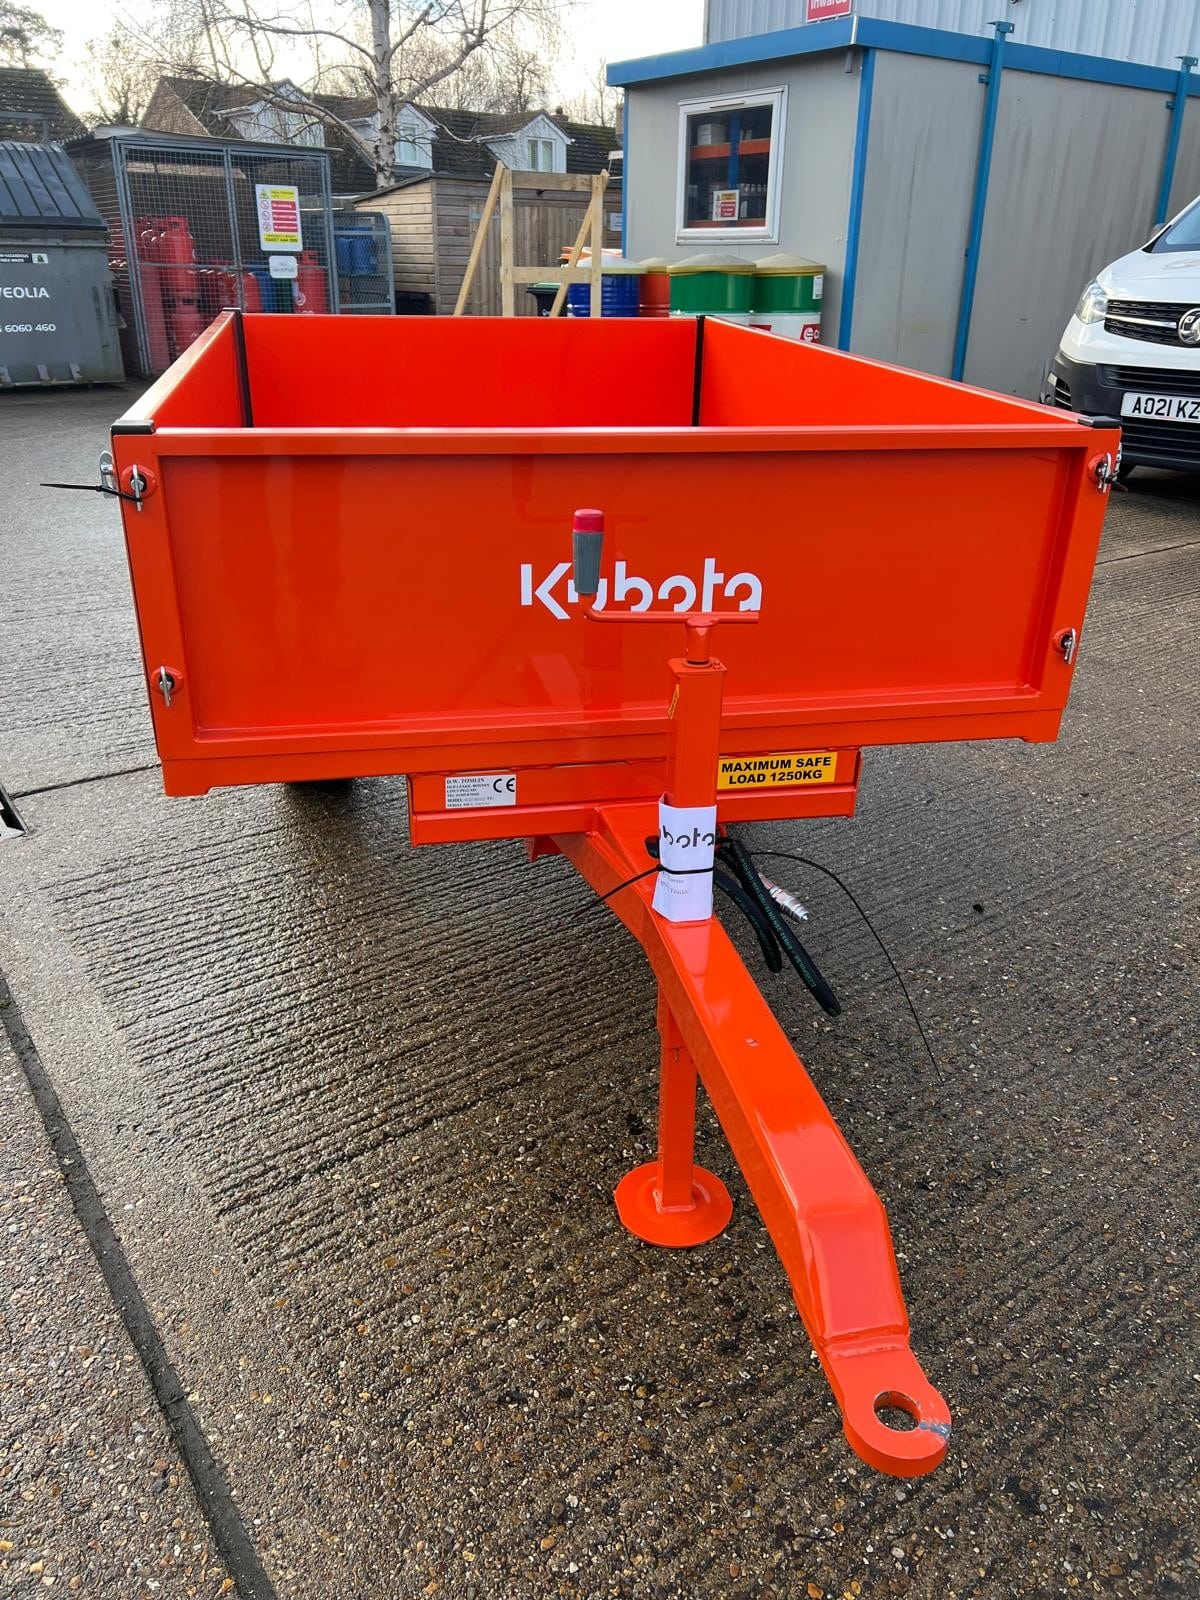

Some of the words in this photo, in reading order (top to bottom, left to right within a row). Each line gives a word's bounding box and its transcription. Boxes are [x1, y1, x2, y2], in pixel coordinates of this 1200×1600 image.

[5, 324, 33, 333] 6060
[35, 323, 56, 332] 460
[721, 759, 791, 773] MAXIMUM
[796, 757, 832, 768] SAFE
[729, 773, 766, 784] LOAD
[770, 770, 822, 782] 1250KG
[493, 778, 515, 793] CE
